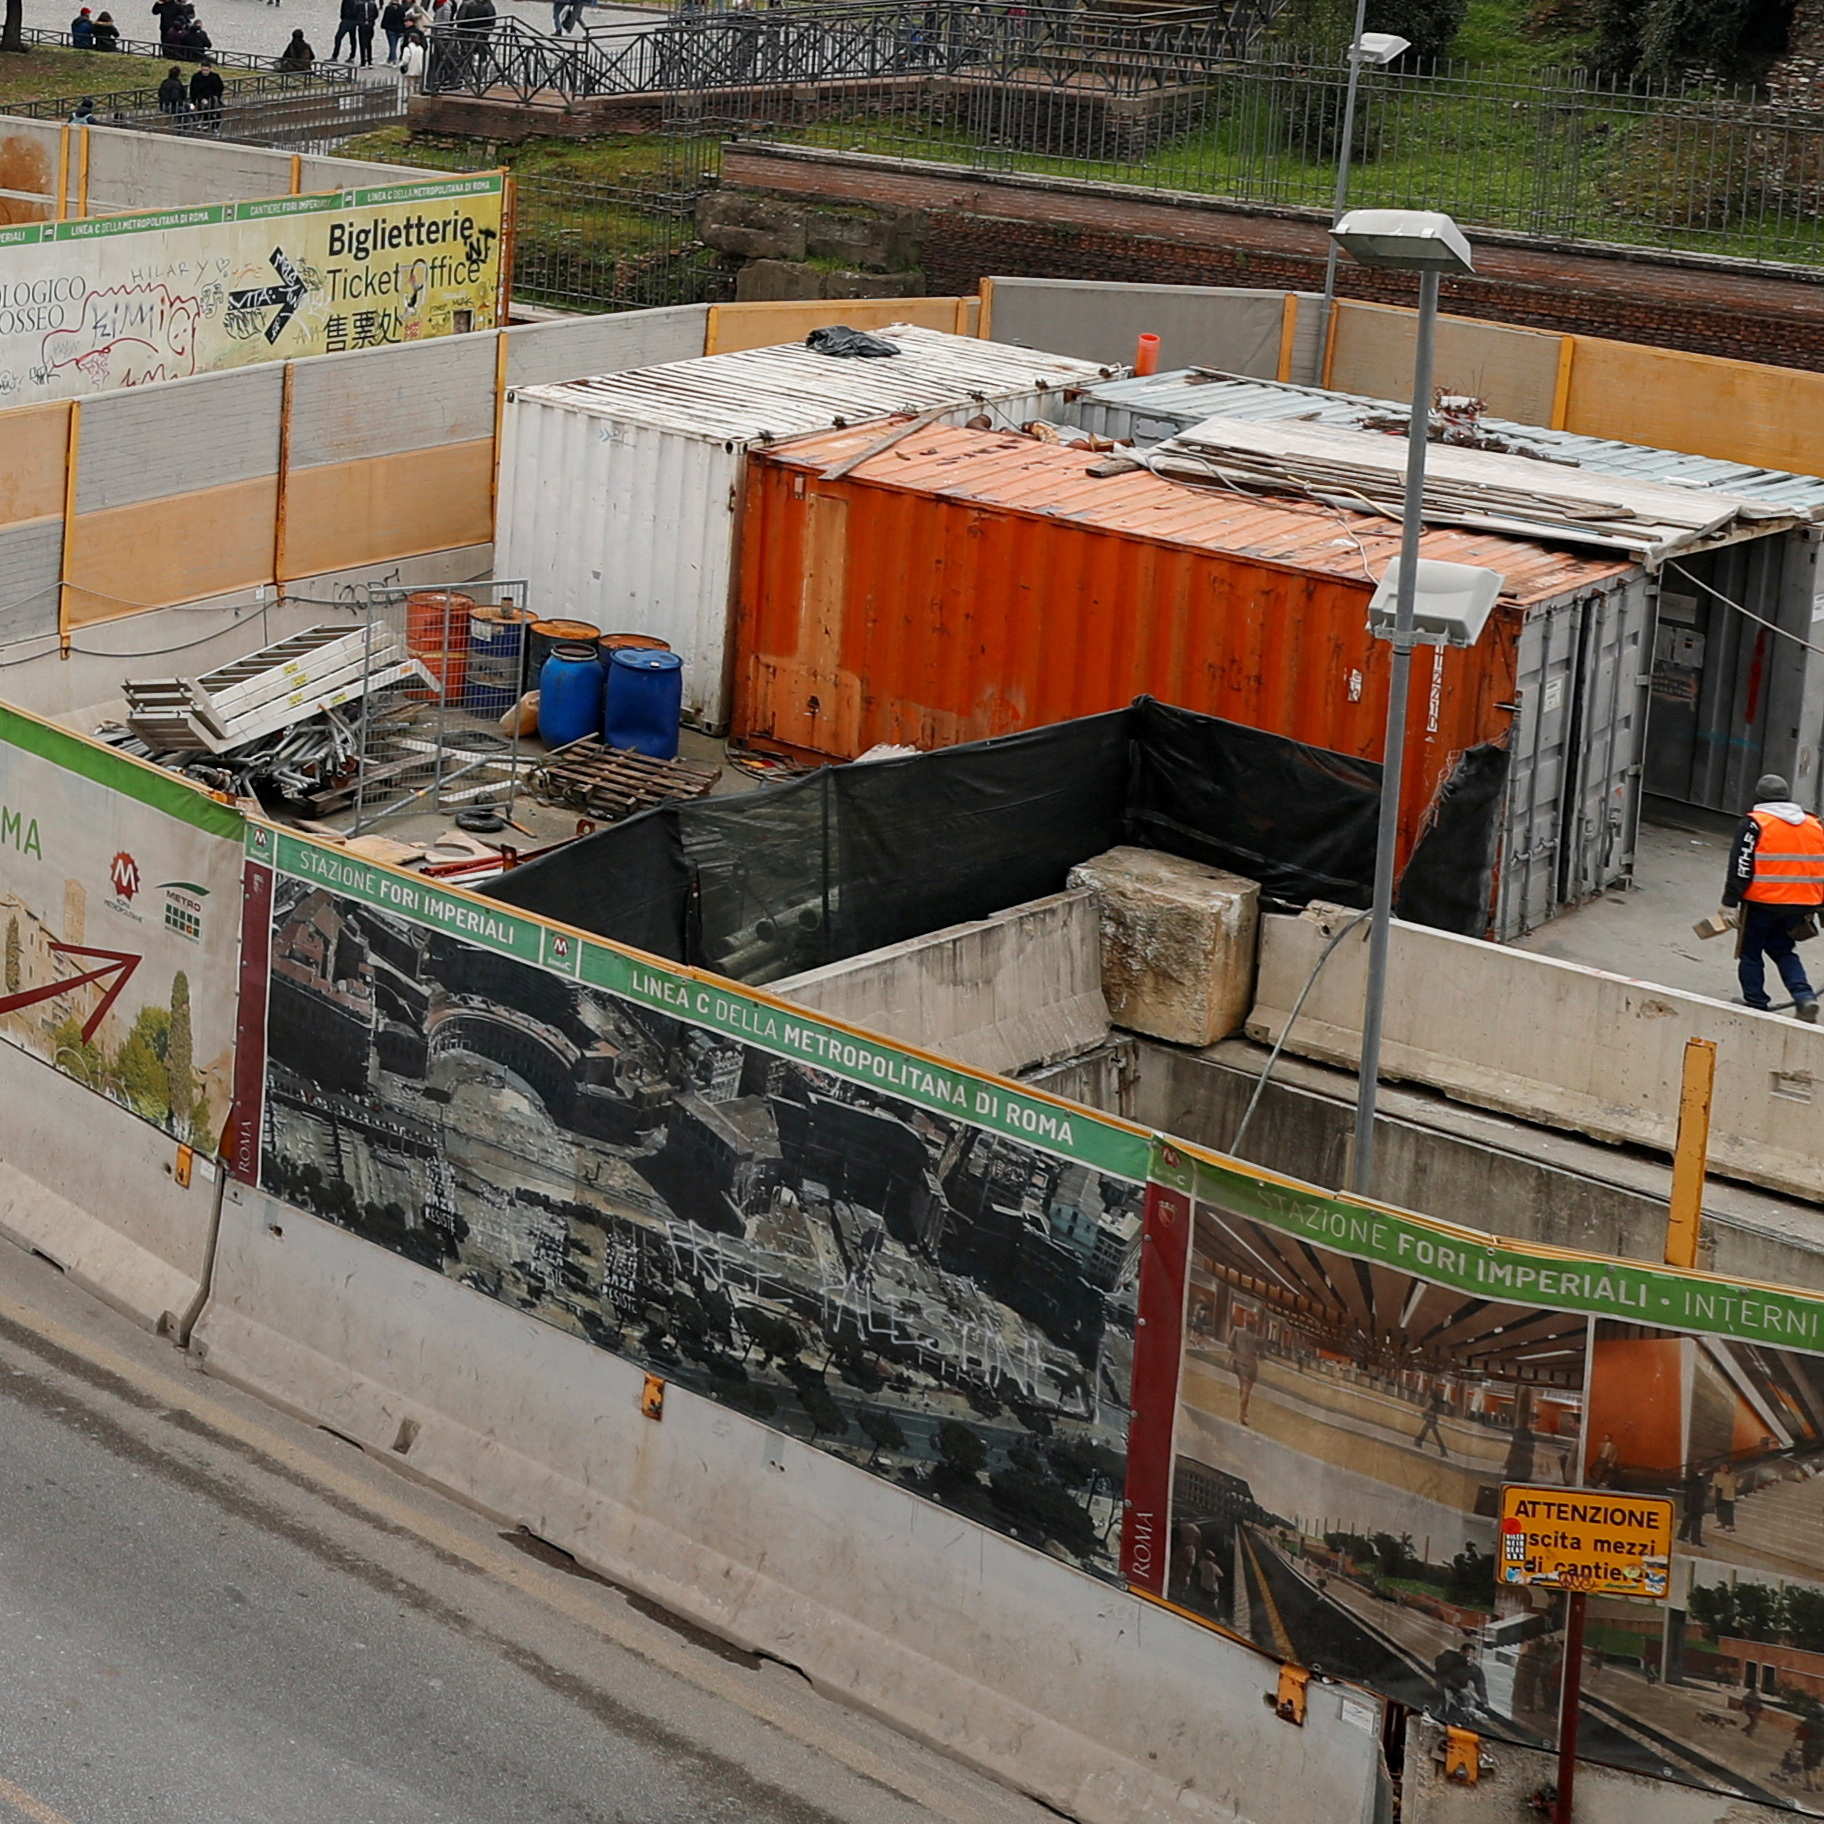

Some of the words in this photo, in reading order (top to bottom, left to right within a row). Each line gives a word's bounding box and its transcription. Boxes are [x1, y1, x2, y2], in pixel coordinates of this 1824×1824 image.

[413, 184, 464, 198] METROPOLITANA
[71, 224, 93, 236] LINEA
[102, 220, 122, 233] DELLA
[123, 214, 179, 231] METROPOLITANA
[250, 204, 281, 216] CANTIERE
[329, 210, 474, 261] Biglietterie
[132, 260, 208, 286] HILARY
[327, 262, 400, 302] Ticket
[411, 256, 480, 289] Office
[166, 890, 201, 912] METRO
[301, 852, 375, 895] STAZIONE
[379, 876, 418, 910] FORI
[424, 899, 513, 945] IMPERIALI
[633, 970, 689, 1009] LINEA
[716, 999, 777, 1040] DELLA
[784, 1024, 968, 1108] METROPOLITANA
[976, 1090, 998, 1118] DI
[1006, 1102, 1073, 1146] ROMA
[238, 1120, 252, 1174] ROMA
[1257, 1190, 1388, 1250] STAZIONE
[1398, 1232, 1465, 1275] FORI
[1476, 1258, 1647, 1308] IMPERIALI
[1685, 1291, 1818, 1338] INTERNI
[1514, 1499, 1660, 1529] ATTENZIONE
[1133, 1512, 1153, 1578] ROMA
[1529, 1531, 1582, 1550] scita
[1594, 1538, 1656, 1556] mezzi
[1524, 1556, 1543, 1573] di
